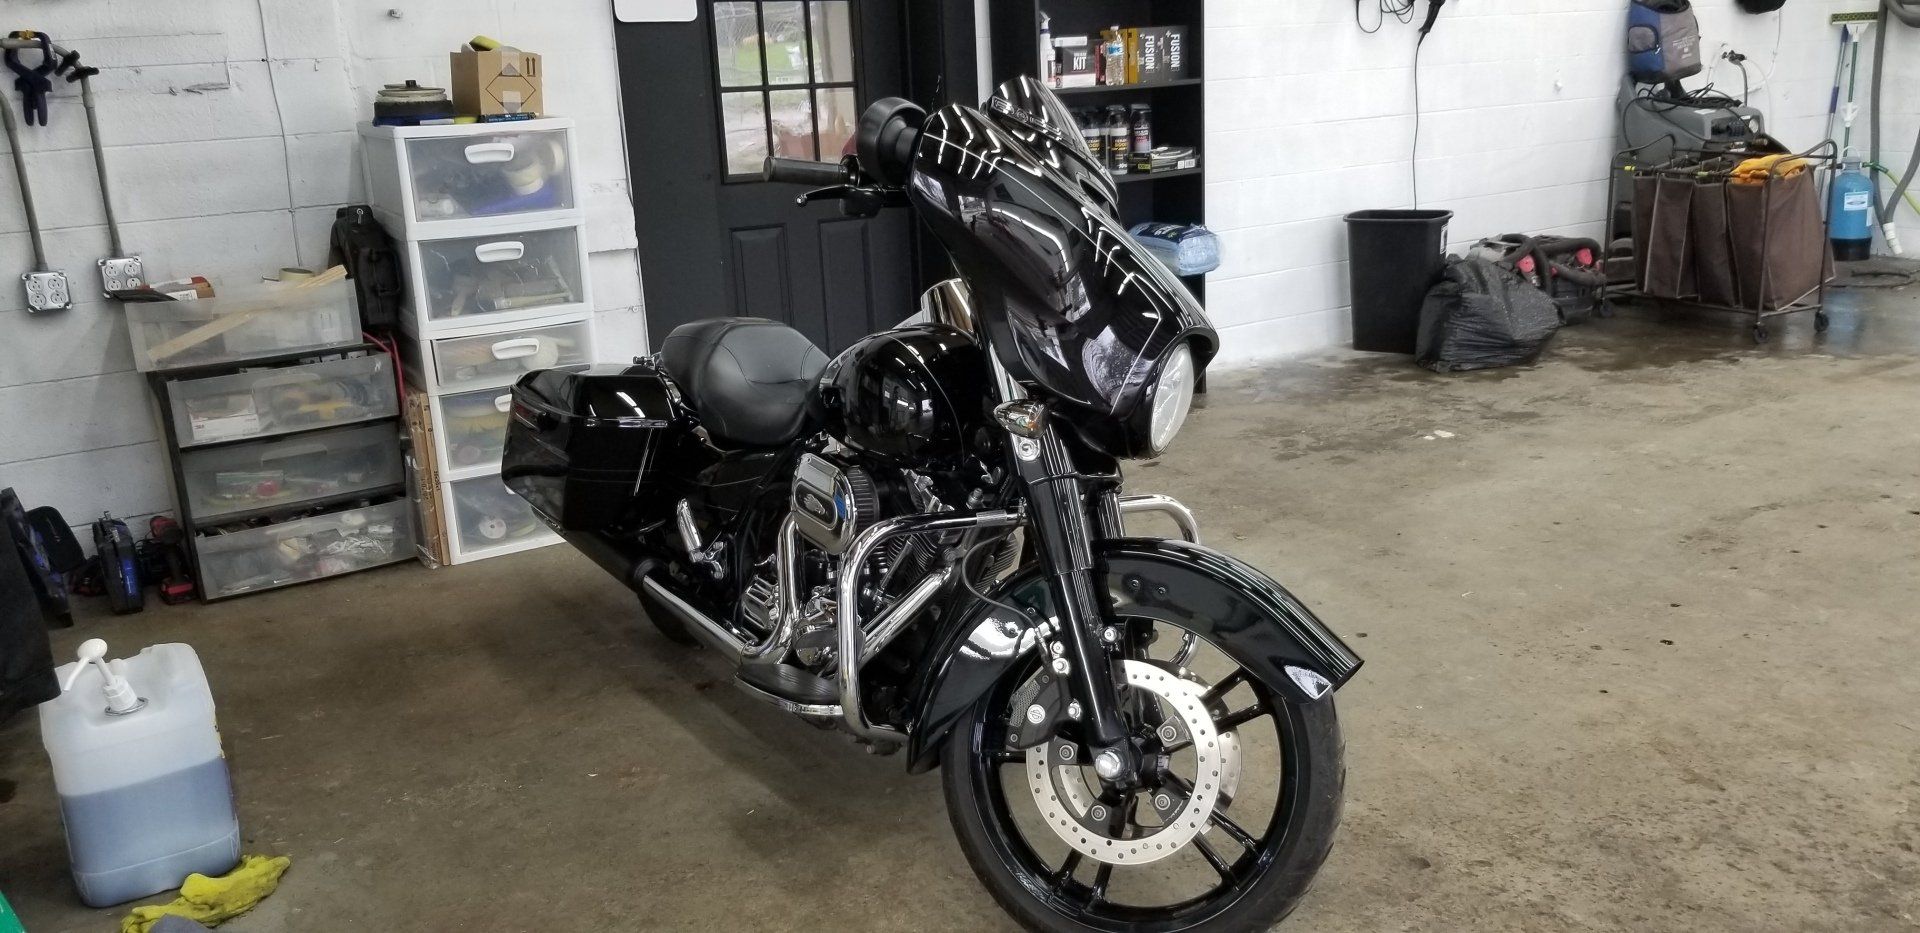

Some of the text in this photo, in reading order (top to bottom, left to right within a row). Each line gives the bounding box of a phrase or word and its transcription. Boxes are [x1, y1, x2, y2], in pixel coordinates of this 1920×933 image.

[1073, 56, 1087, 70] KIT
[1145, 35, 1155, 70] FUSION
[1170, 33, 1181, 68] FUSION
